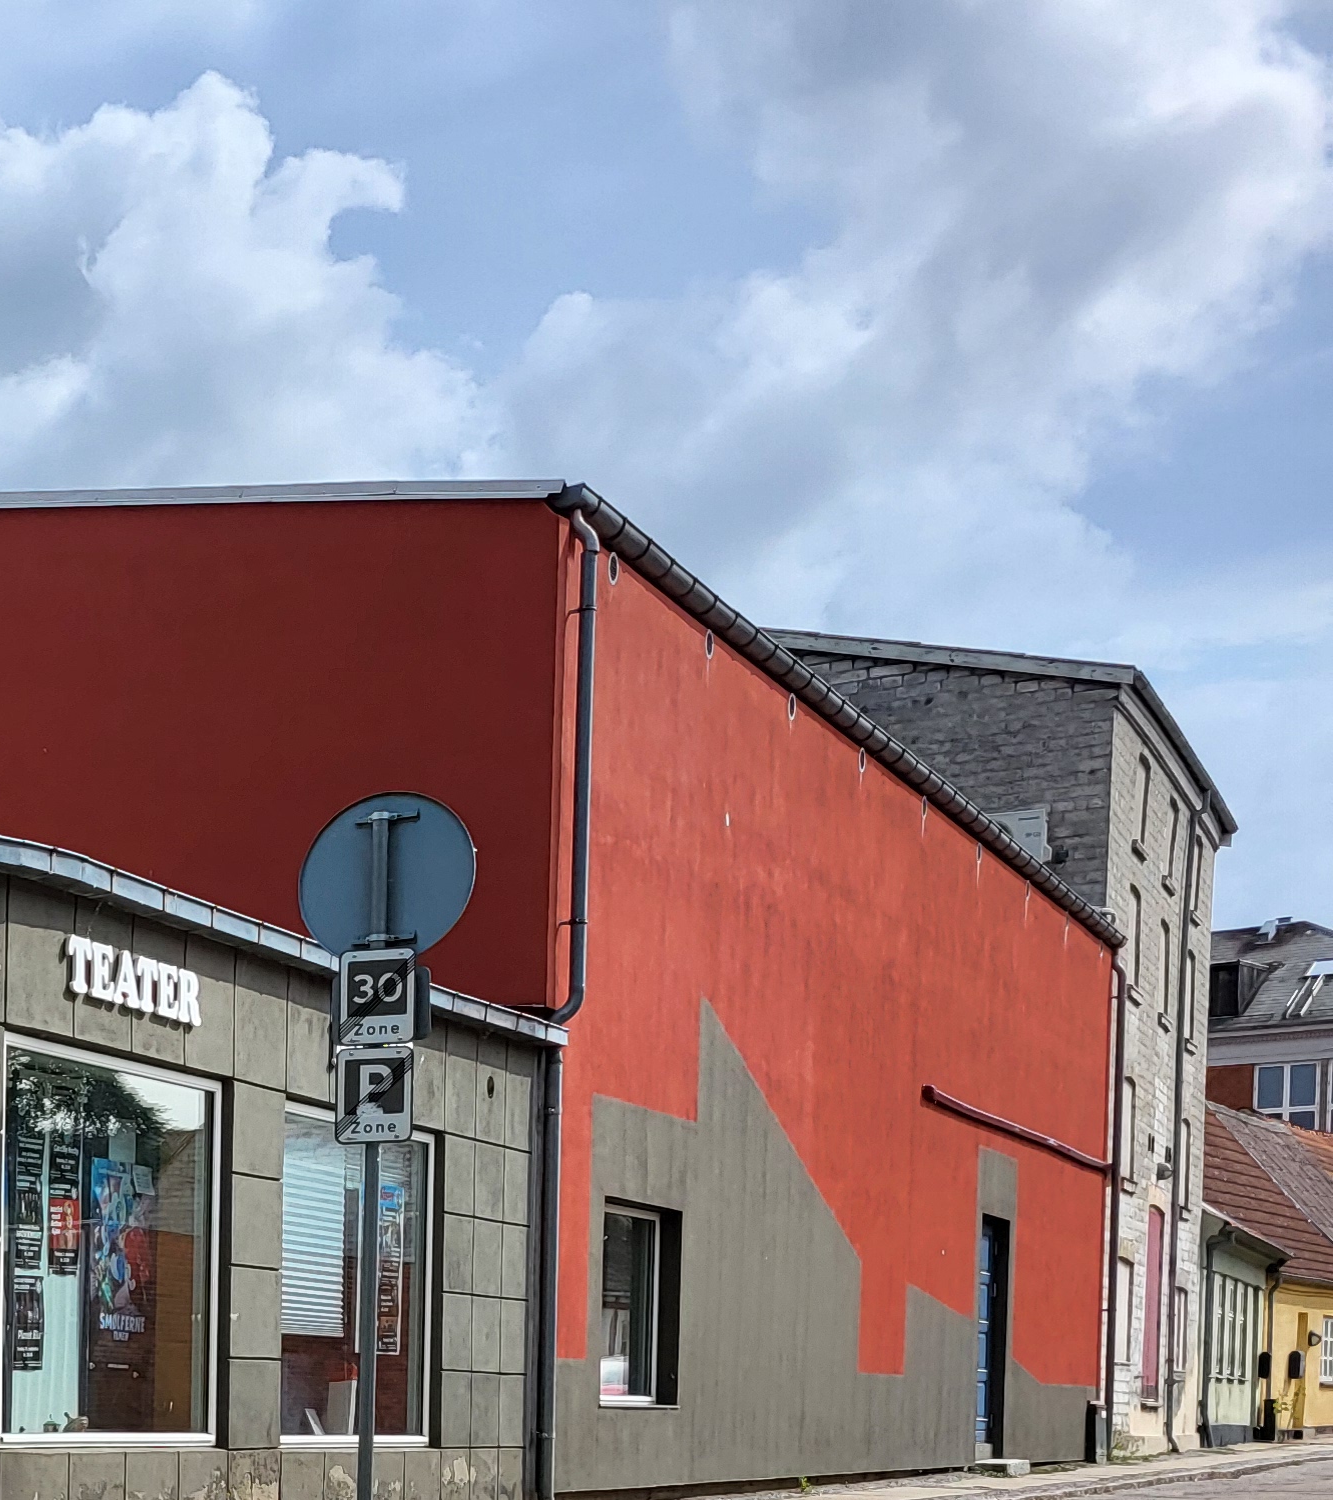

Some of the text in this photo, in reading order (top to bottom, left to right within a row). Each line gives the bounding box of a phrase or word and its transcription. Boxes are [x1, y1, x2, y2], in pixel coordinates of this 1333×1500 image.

[68, 933, 202, 1026] TEATER
[352, 972, 402, 1004] 30
[353, 1023, 400, 1037] Zone
[359, 1064, 394, 1110] P
[350, 1120, 397, 1135] Zone
